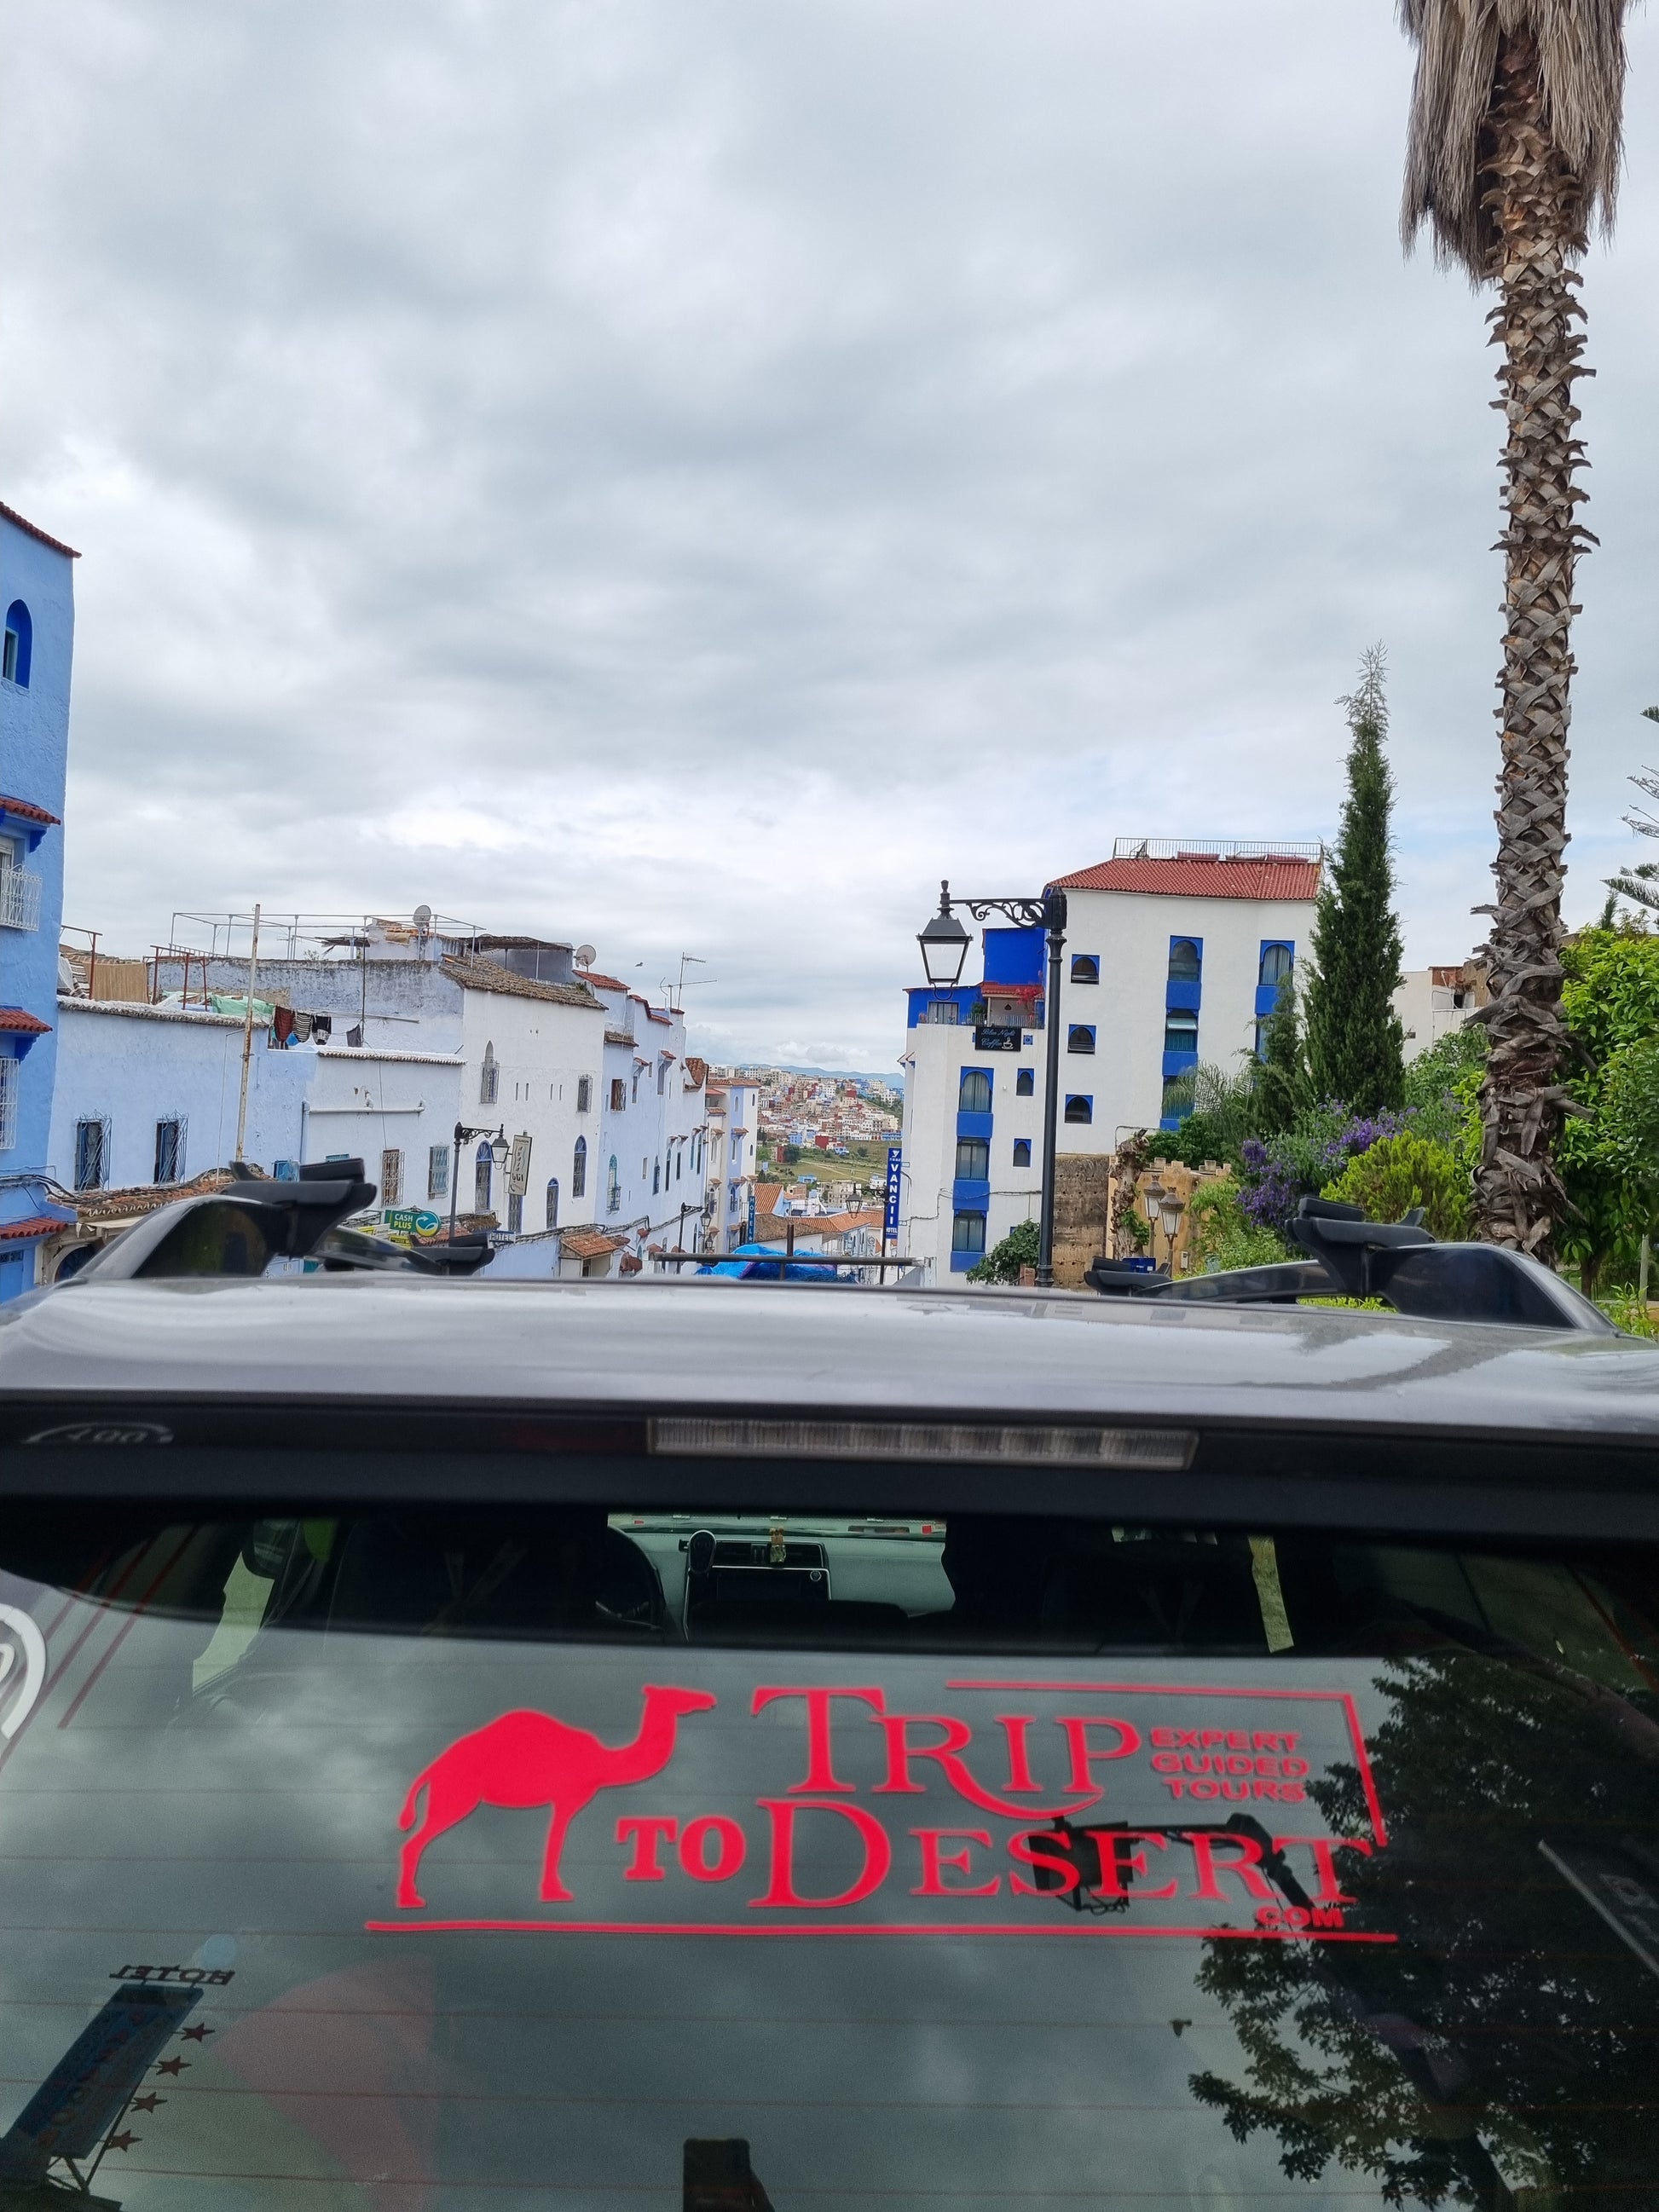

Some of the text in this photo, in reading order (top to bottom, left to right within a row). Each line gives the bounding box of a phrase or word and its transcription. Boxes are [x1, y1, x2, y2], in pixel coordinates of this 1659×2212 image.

[393, 1221, 412, 1229] PLUS
[395, 1213, 413, 1222] CASH
[490, 1233, 512, 1241] HOTEL
[1151, 1727, 1302, 1752] EXPERT
[1152, 1752, 1309, 1776] GUIDED
[1163, 1777, 1306, 1803] TOURS
[616, 1798, 1373, 1909] TO DESERT
